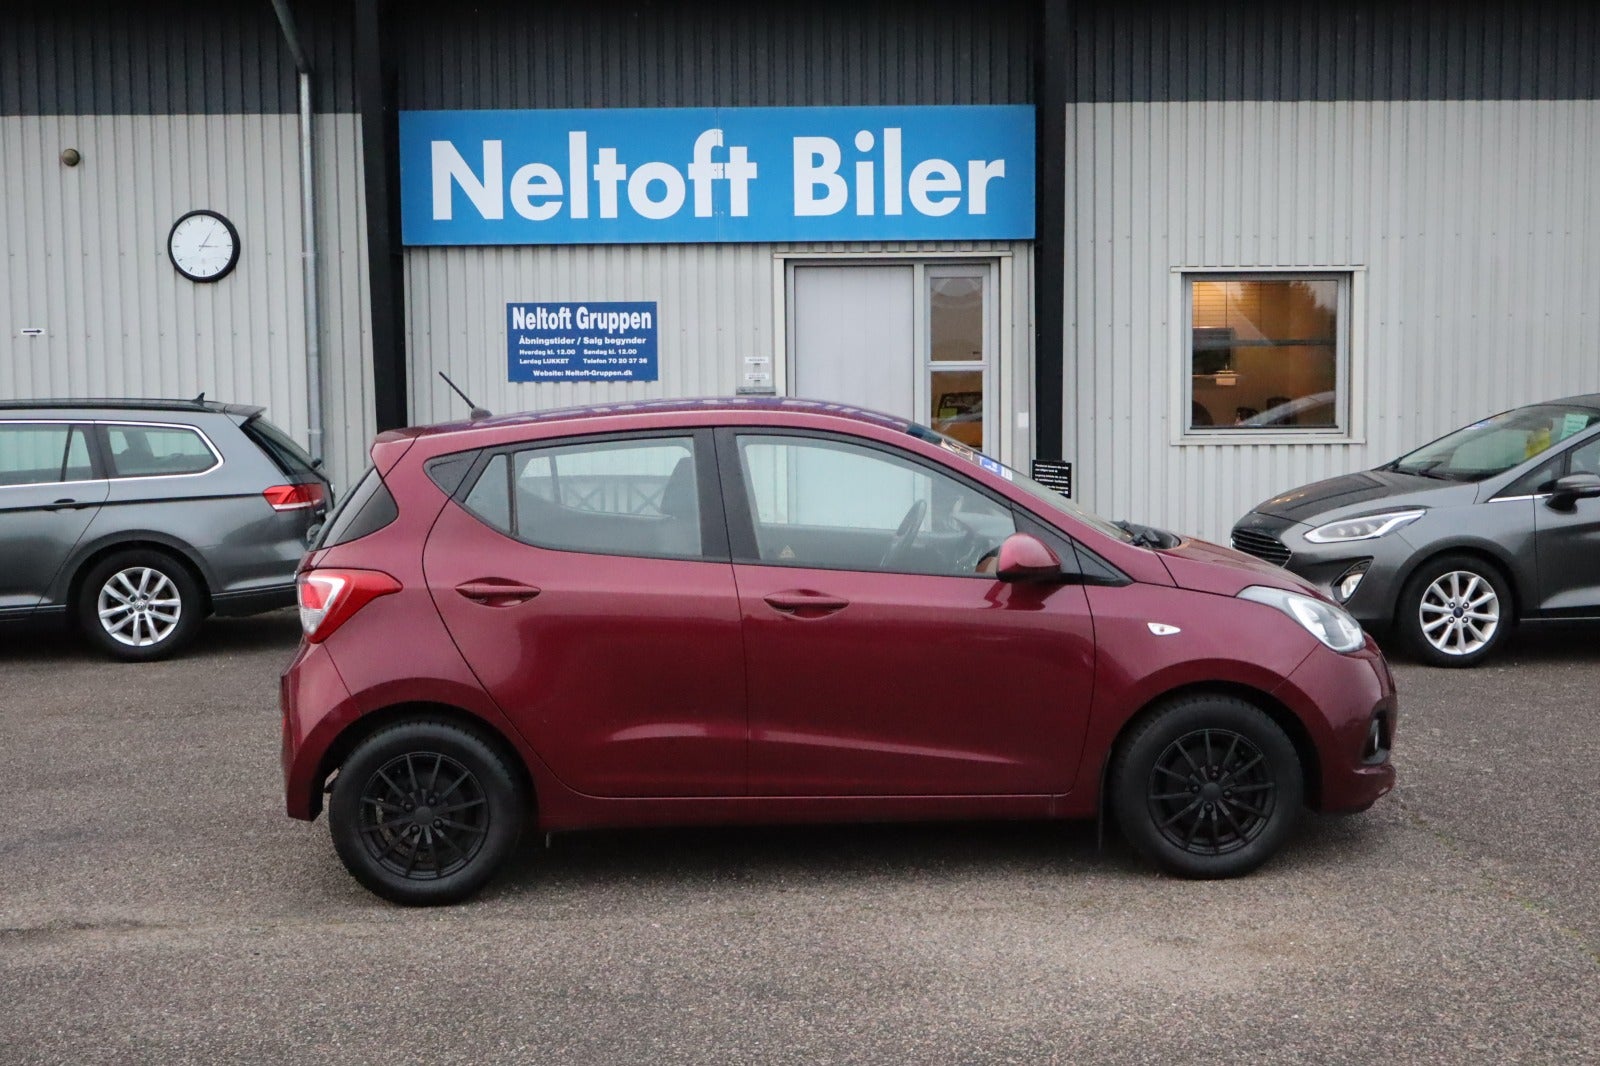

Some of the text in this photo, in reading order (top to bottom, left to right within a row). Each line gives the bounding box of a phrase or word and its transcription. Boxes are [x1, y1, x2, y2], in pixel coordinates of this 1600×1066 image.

[432, 128, 1004, 220] Neltoft Biler
[513, 307, 651, 334] Neltoft Gruppen
[519, 335, 576, 346] Åbningstider
[583, 336, 602, 346] Salg
[605, 336, 646, 346] begynder
